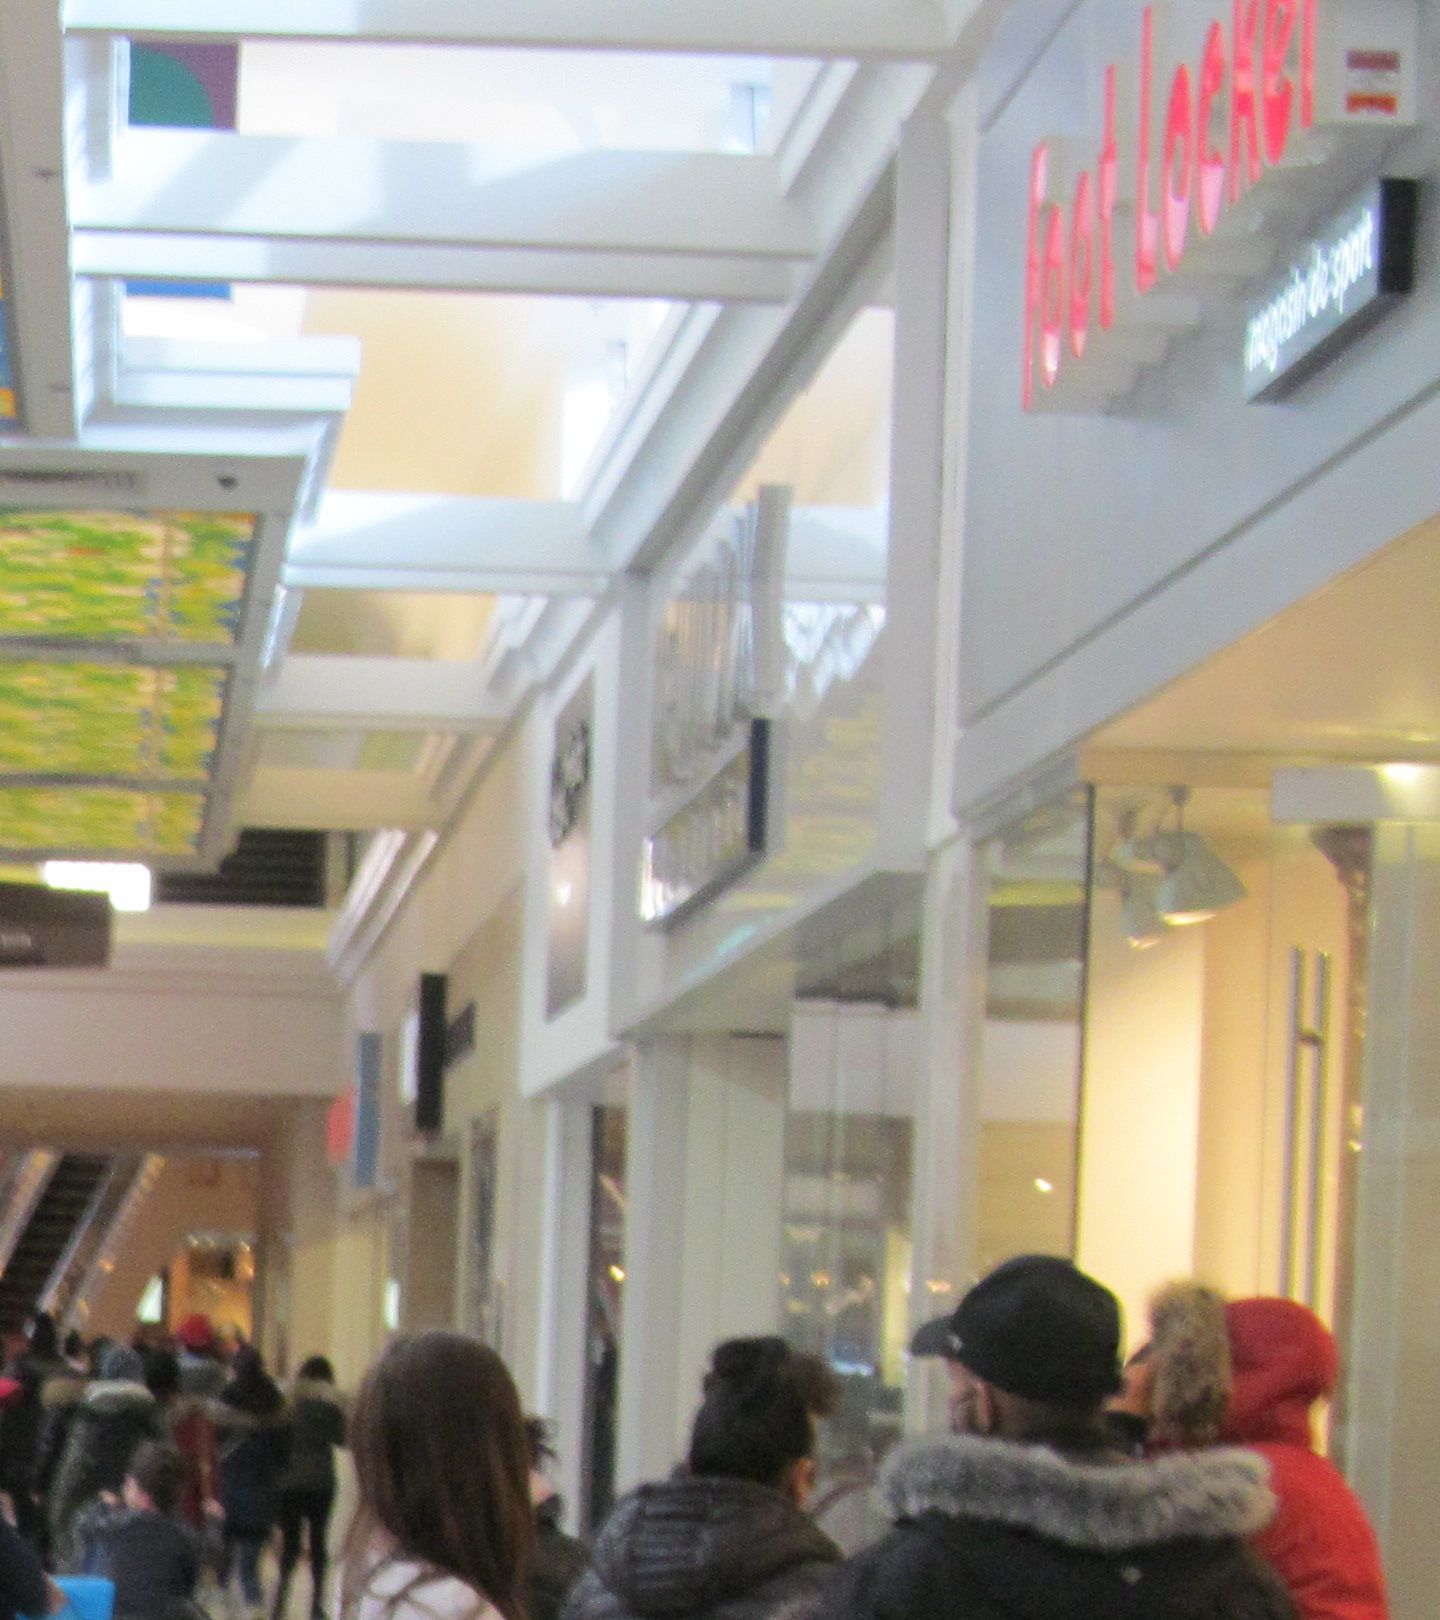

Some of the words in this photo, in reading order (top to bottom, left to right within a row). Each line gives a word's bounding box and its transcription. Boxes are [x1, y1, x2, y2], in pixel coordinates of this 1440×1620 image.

[1022, 64, 1118, 412] Foot
[1244, 264, 1308, 374] magasin
[1308, 241, 1329, 319] de
[1330, 207, 1374, 315] sport
